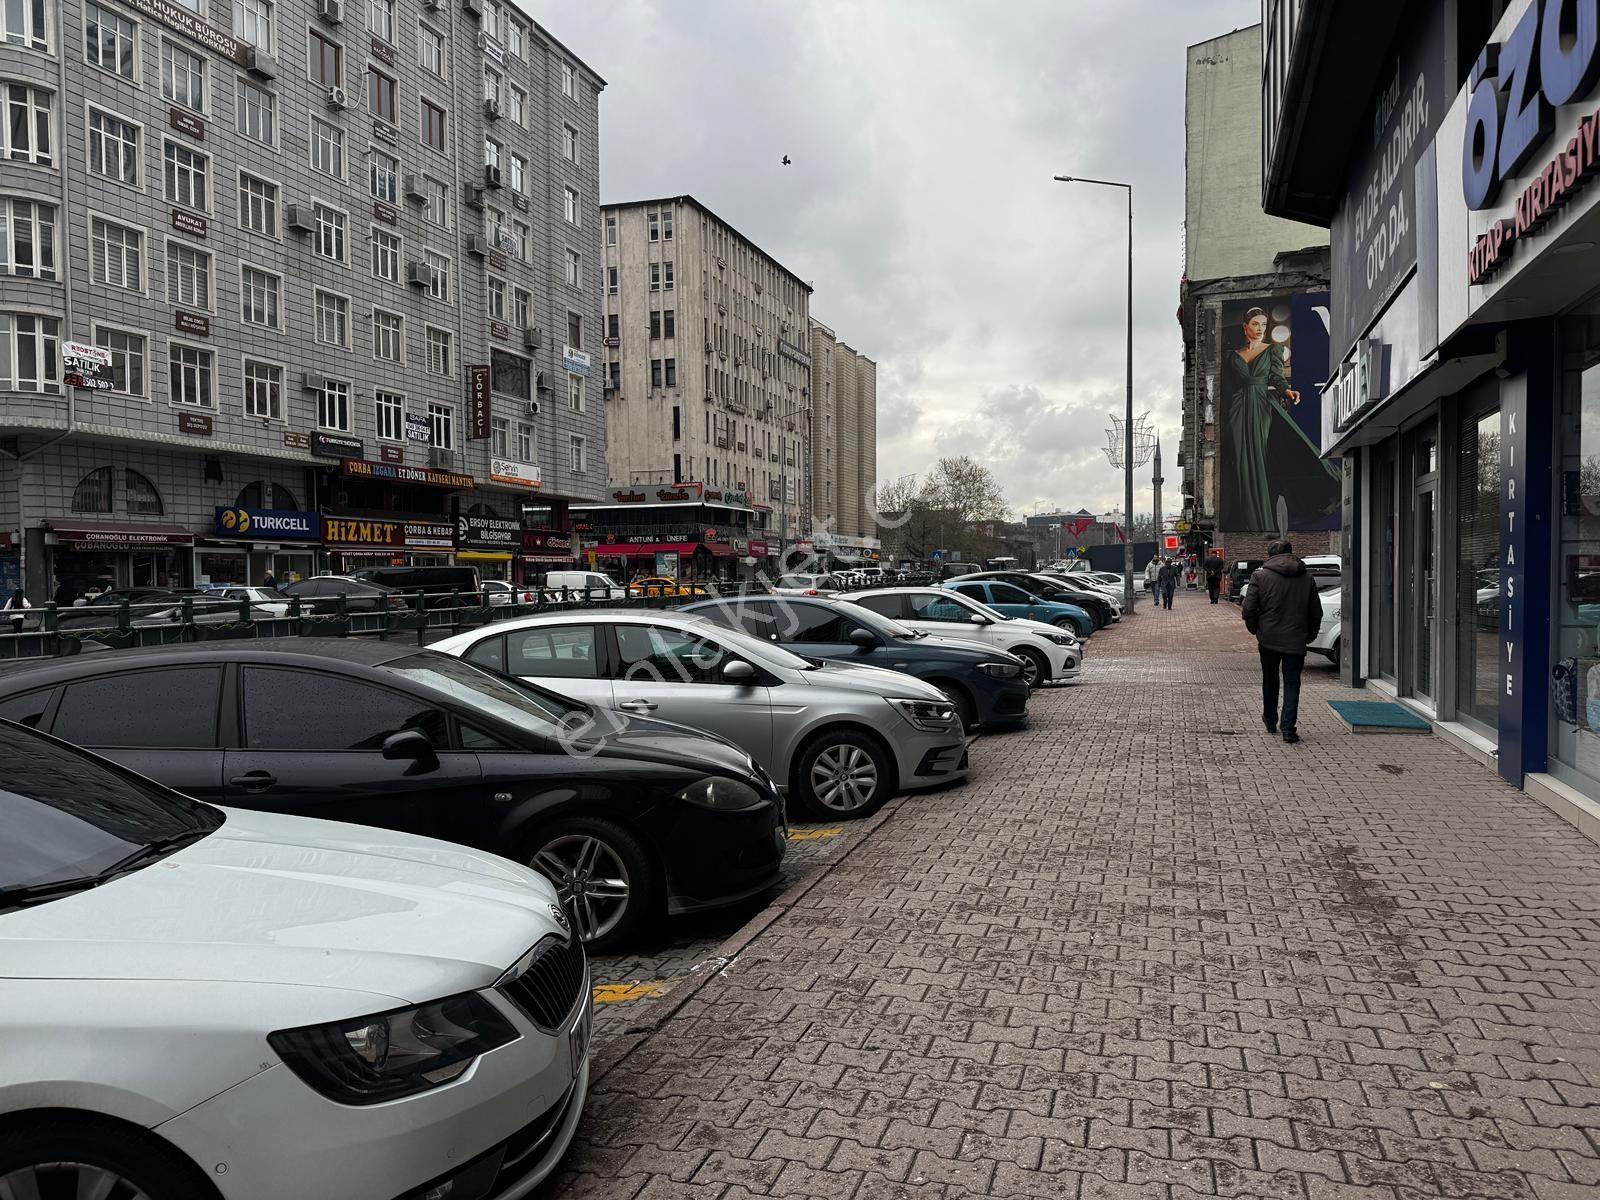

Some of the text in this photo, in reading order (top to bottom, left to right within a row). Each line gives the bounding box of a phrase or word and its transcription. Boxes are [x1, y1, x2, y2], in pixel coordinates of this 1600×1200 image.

[153, 0, 237, 51] HUKUK BÜROSU
[197, 32, 236, 59] KORKMAZ
[1355, 72, 1429, 253] EV DE ALDIRIR,
[1468, 219, 1503, 286] KİTAP
[1516, 107, 1600, 239] KIRTASİY
[177, 214, 202, 227] AVUKAT
[1366, 222, 1387, 290] OTO
[1388, 189, 1409, 258] DA.
[64, 356, 100, 373] SATILIK
[476, 373, 484, 436] ÇORBACI
[407, 429, 429, 442] SATILIK
[349, 461, 372, 475] ÇORBA
[372, 464, 397, 478] IZGARA
[398, 468, 406, 479] ET
[406, 467, 426, 481] DÖNER
[427, 471, 451, 484] KAYSERİ
[252, 516, 309, 531] TURKCELL
[404, 525, 454, 537] ÇORBA & KEBAP
[469, 517, 521, 530] ERSOY ELEKTRONİK
[86, 533, 168, 542] ÇOBANOĞLU ELEKTRONİK
[480, 528, 512, 541] BİLGİSAYAR
[625, 535, 653, 543] ANTUNİ
[661, 534, 688, 543] ÜNEFE
[1506, 412, 1516, 696] KIRTASİYE
